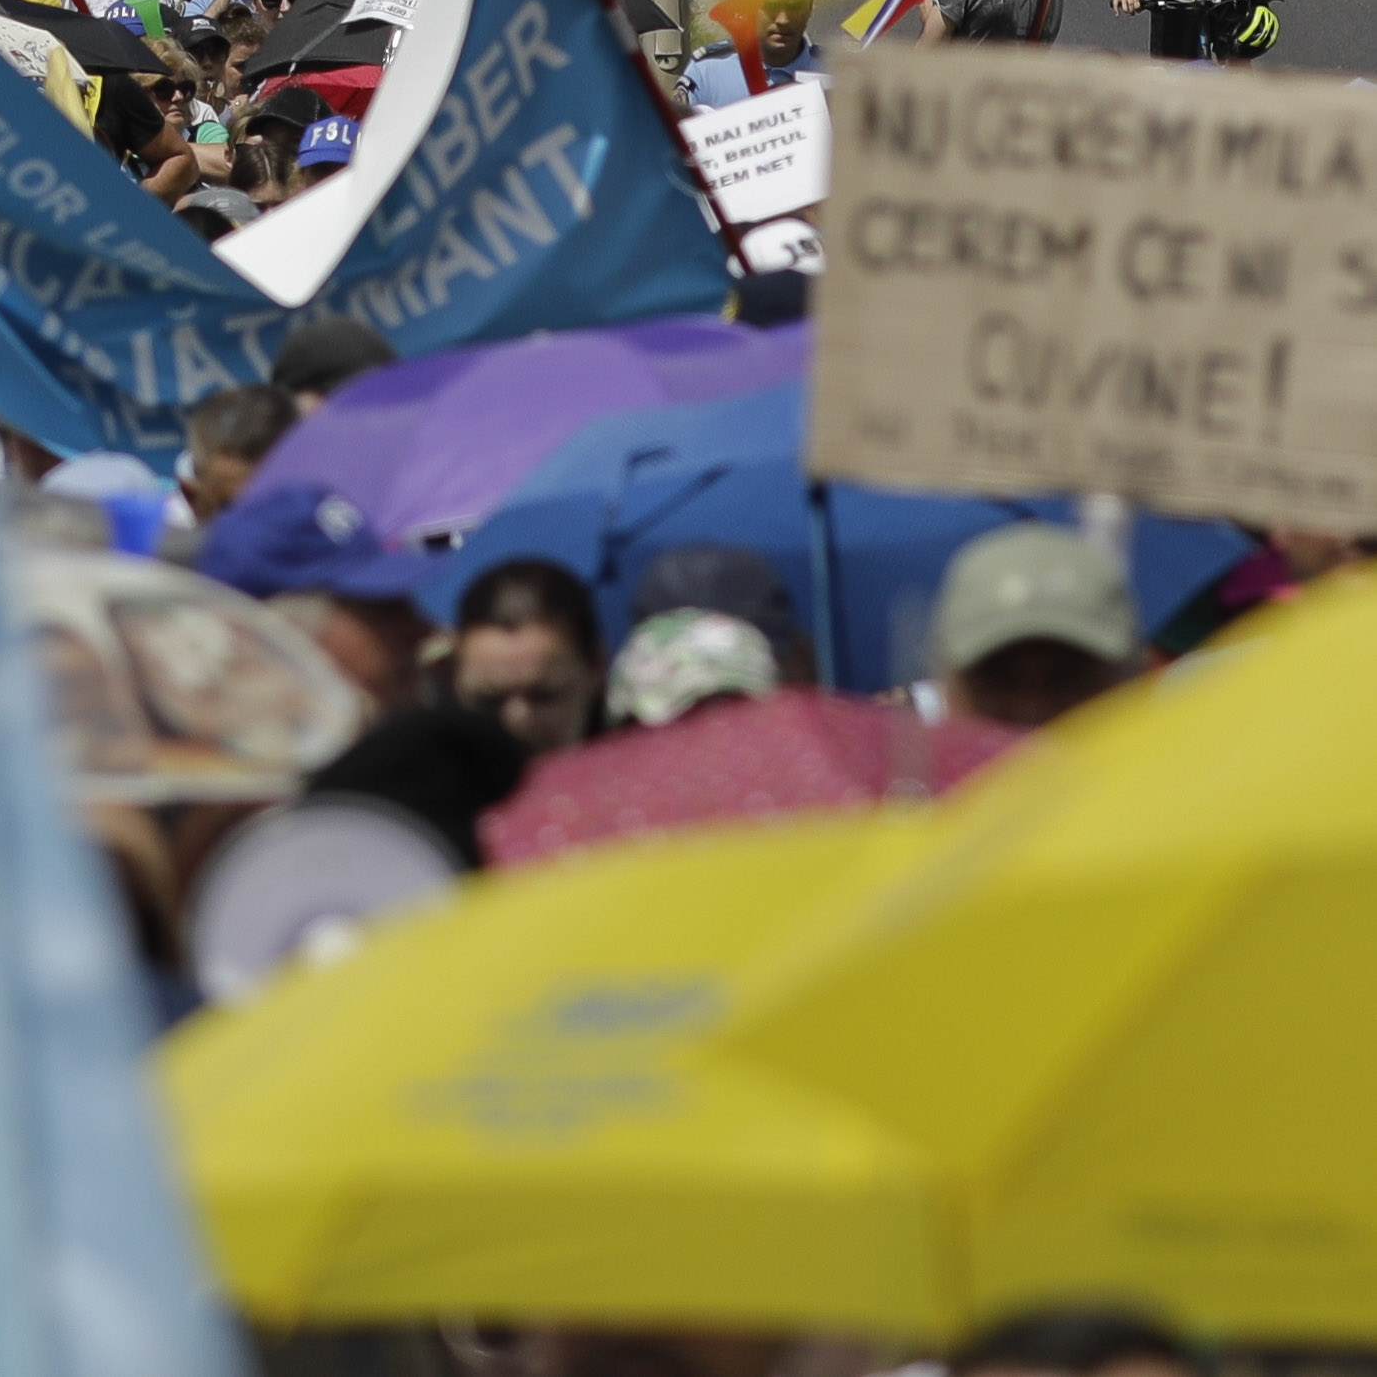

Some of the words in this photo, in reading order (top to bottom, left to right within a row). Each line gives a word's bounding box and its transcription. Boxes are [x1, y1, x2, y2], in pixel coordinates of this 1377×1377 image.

[704, 126, 741, 148] MAI
[748, 105, 804, 134] MULT
[725, 130, 807, 164] BRUTUL
[705, 168, 750, 191] REM
[756, 154, 794, 178] NET
